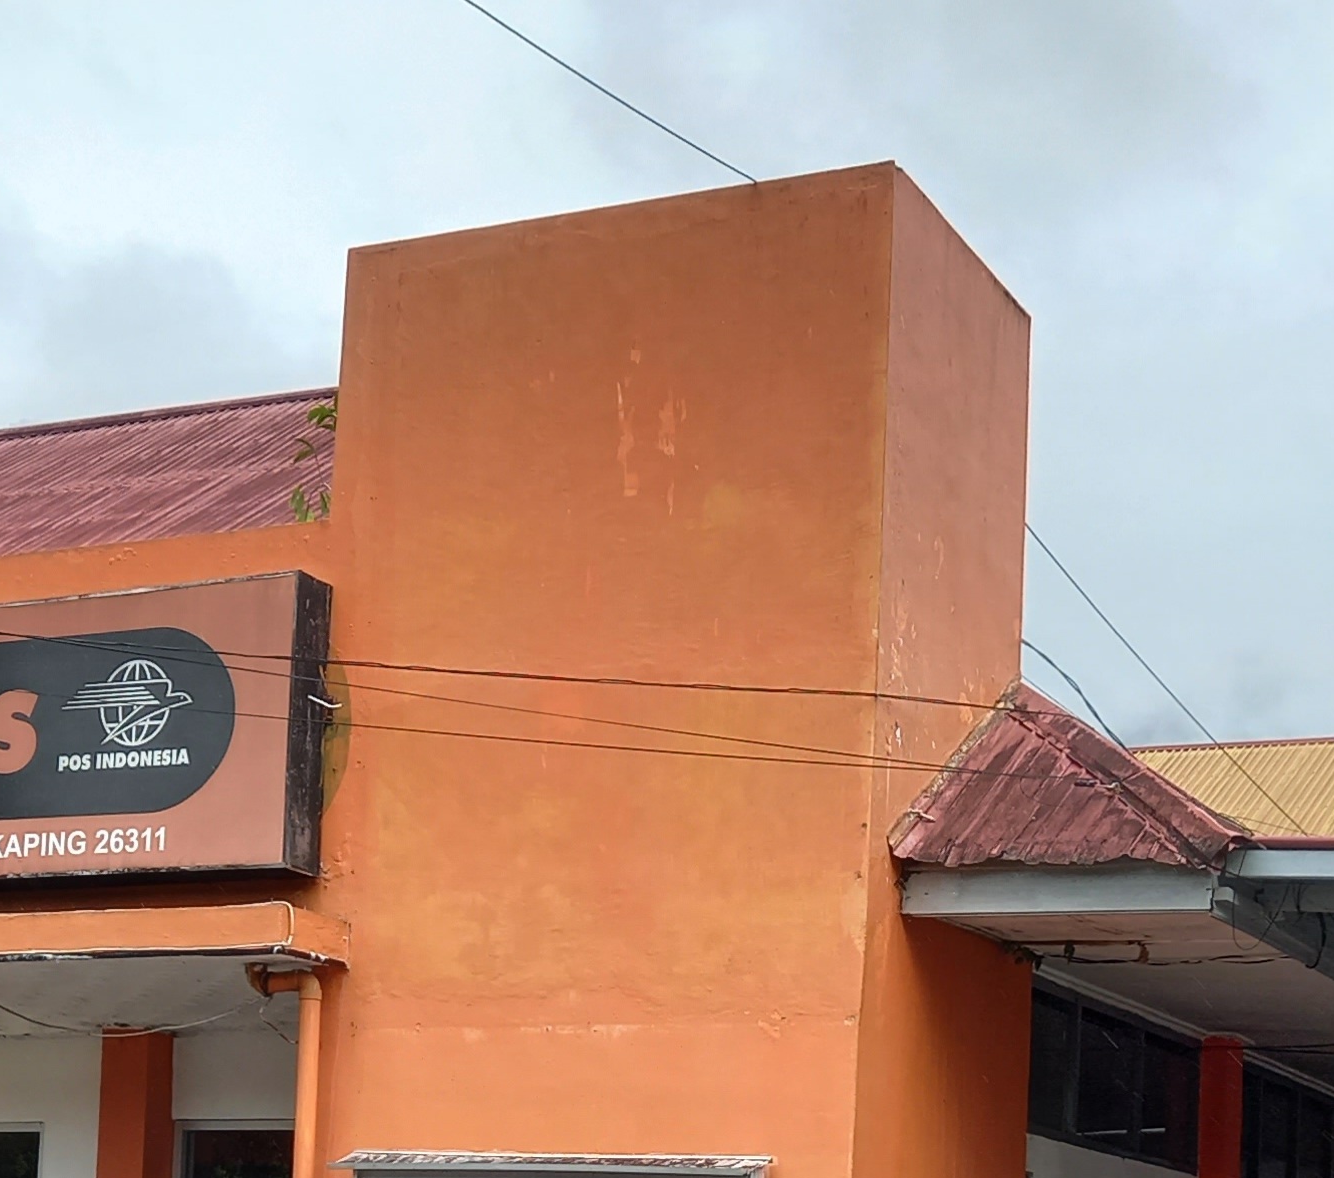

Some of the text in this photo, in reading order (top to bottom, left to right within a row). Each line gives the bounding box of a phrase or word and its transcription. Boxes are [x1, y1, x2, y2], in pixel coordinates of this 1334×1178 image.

[57, 747, 190, 772] POS INDONESIA
[93, 826, 166, 855] 26311
